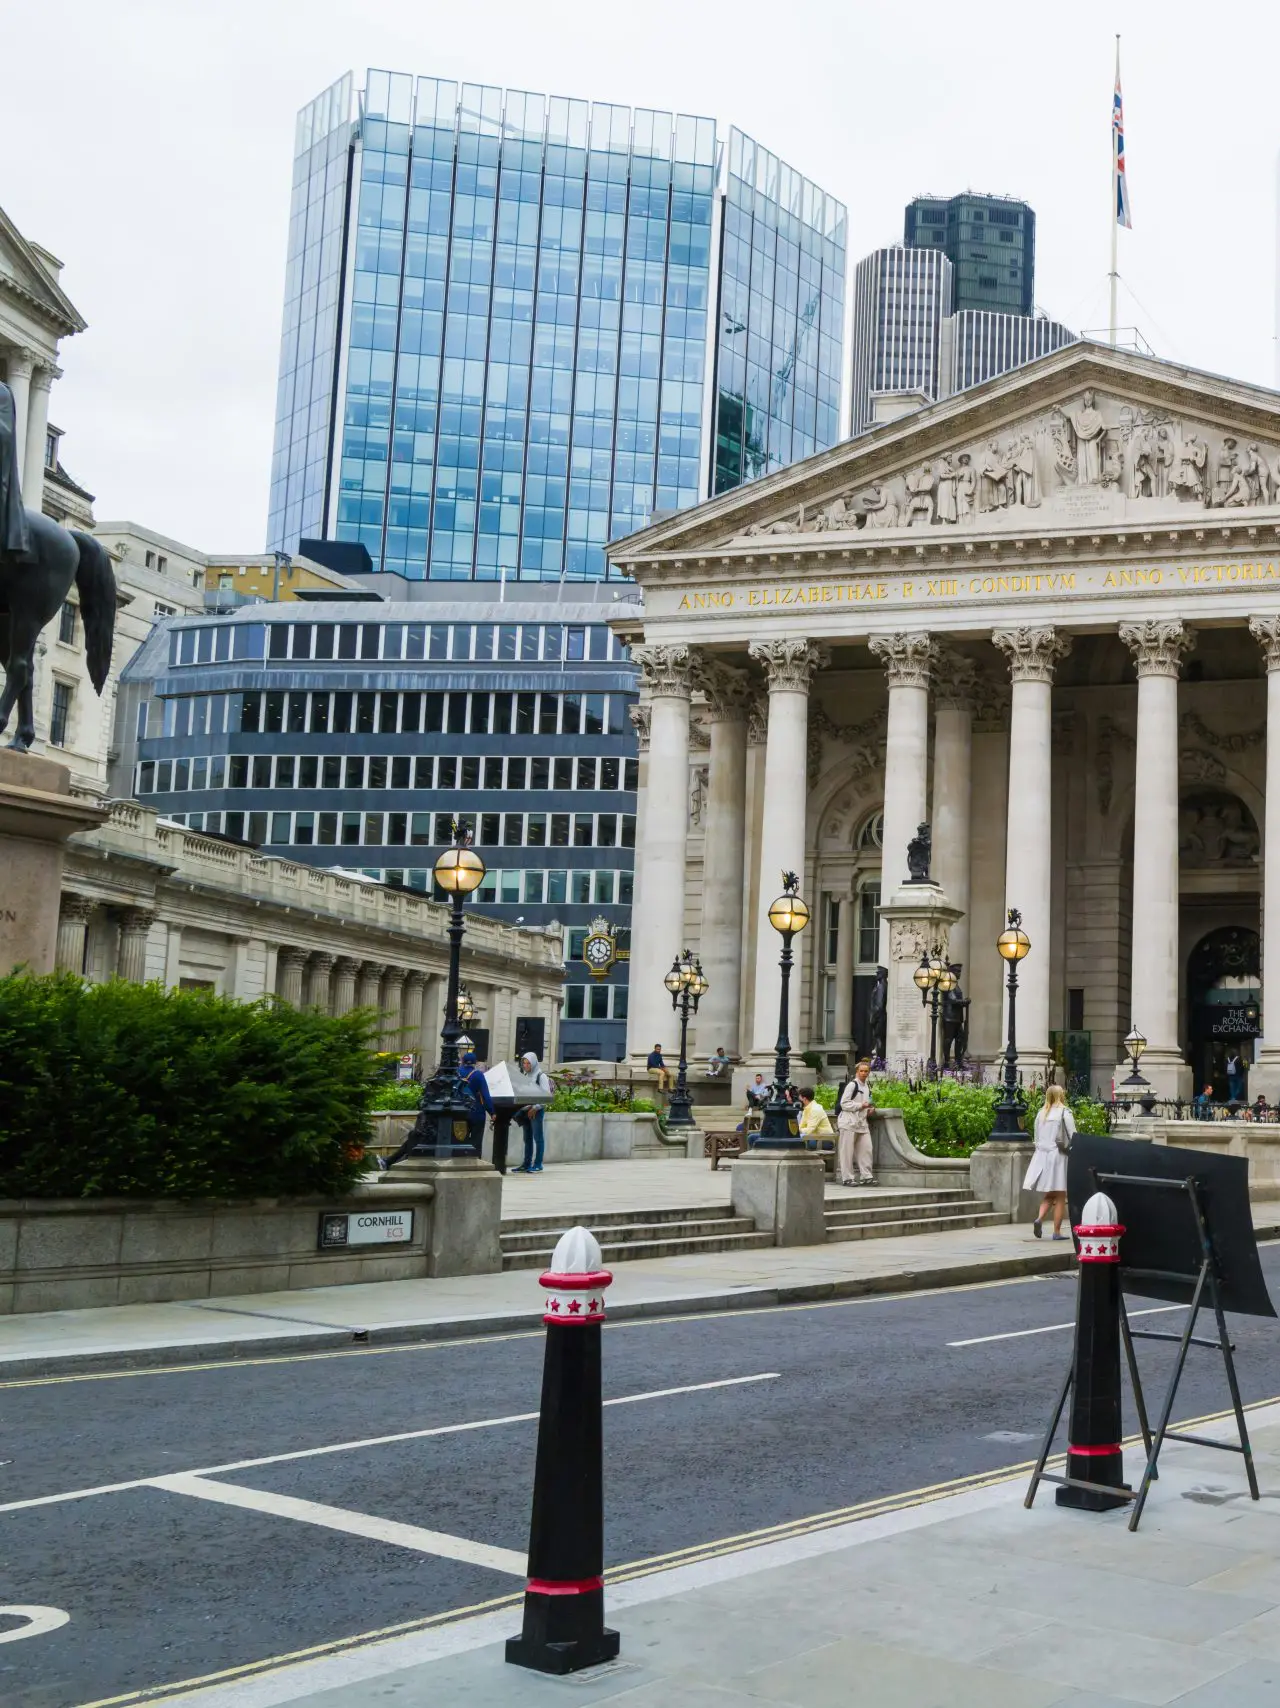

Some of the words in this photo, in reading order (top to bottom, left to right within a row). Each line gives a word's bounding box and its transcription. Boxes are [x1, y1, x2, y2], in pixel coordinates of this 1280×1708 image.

[678, 591, 734, 610] ANNO
[748, 583, 889, 606] ELIZABETHAE
[902, 581, 913, 598] R
[927, 579, 958, 597] XIII
[969, 573, 1076, 594] CONDITVM
[1102, 568, 1162, 588] ANNO
[1228, 1009, 1245, 1018] THE
[1222, 1017, 1249, 1025] ROYAL
[1212, 1024, 1260, 1033] EXCHANGE
[357, 1215, 404, 1228] CORNHILL
[386, 1227, 404, 1238] EC3
